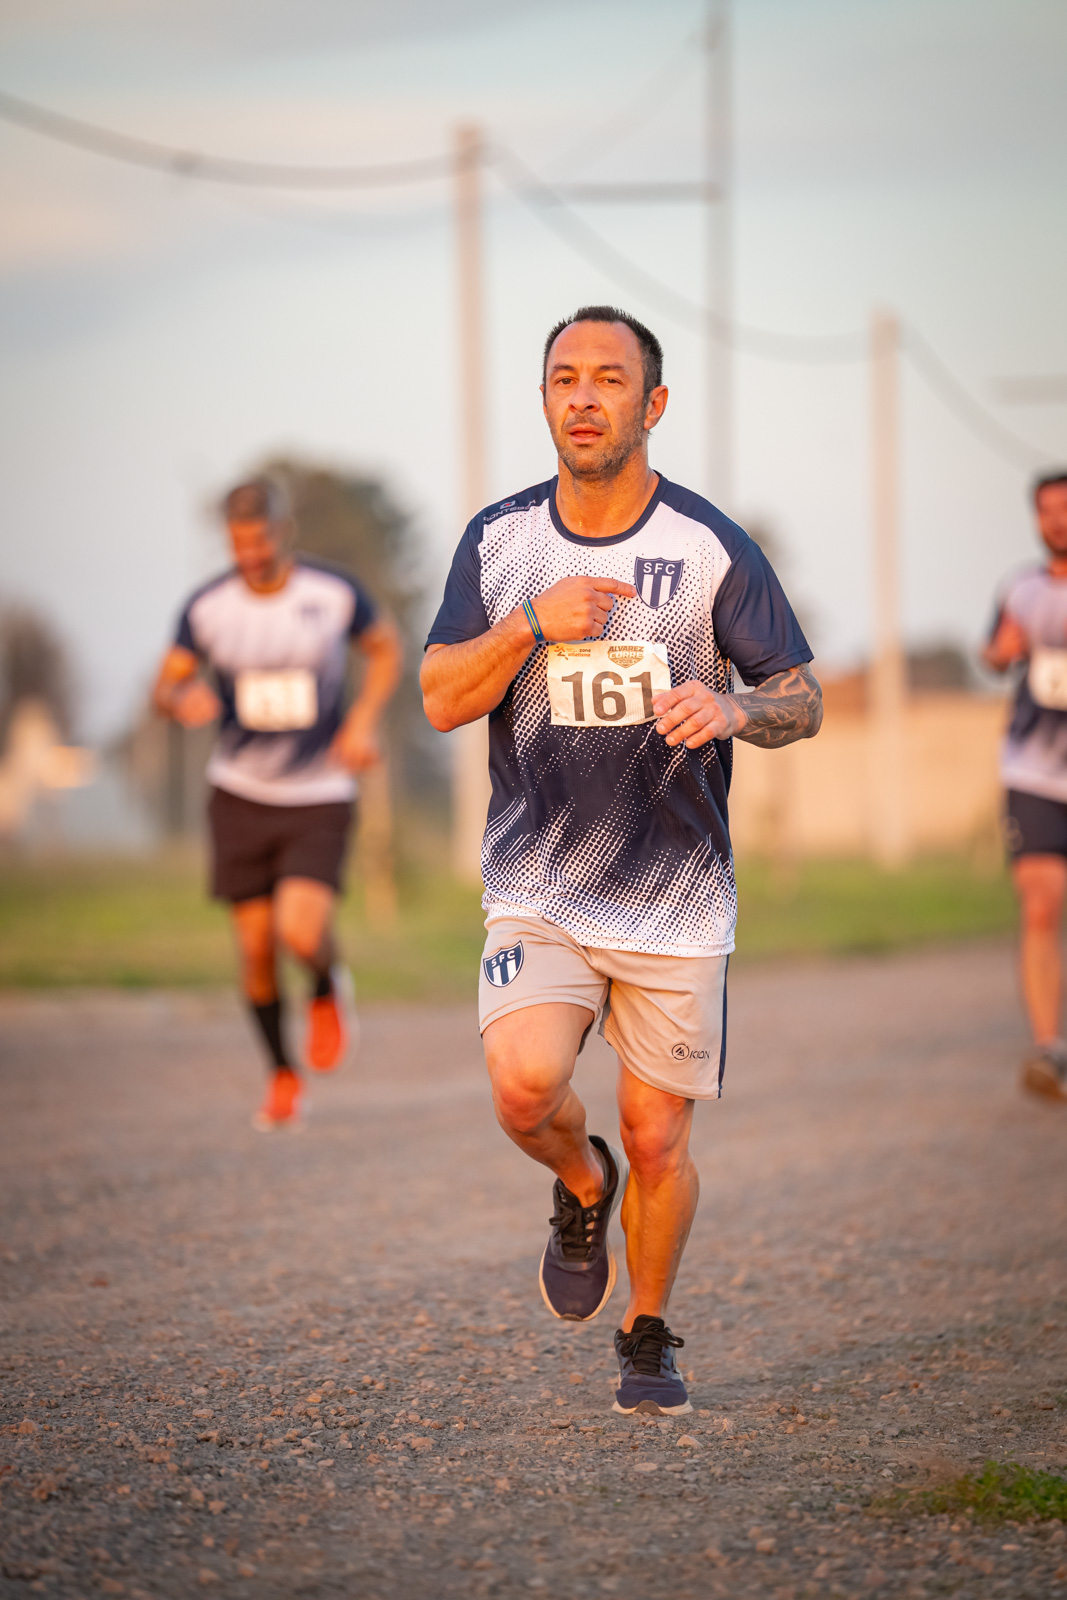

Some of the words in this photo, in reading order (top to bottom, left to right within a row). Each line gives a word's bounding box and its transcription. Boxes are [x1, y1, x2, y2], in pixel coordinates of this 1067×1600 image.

[643, 562, 676, 575] SFC
[608, 645, 645, 653] ALVAREZ
[610, 651, 644, 659] CORRE
[561, 671, 655, 721] 161
[491, 950, 516, 967] SFC
